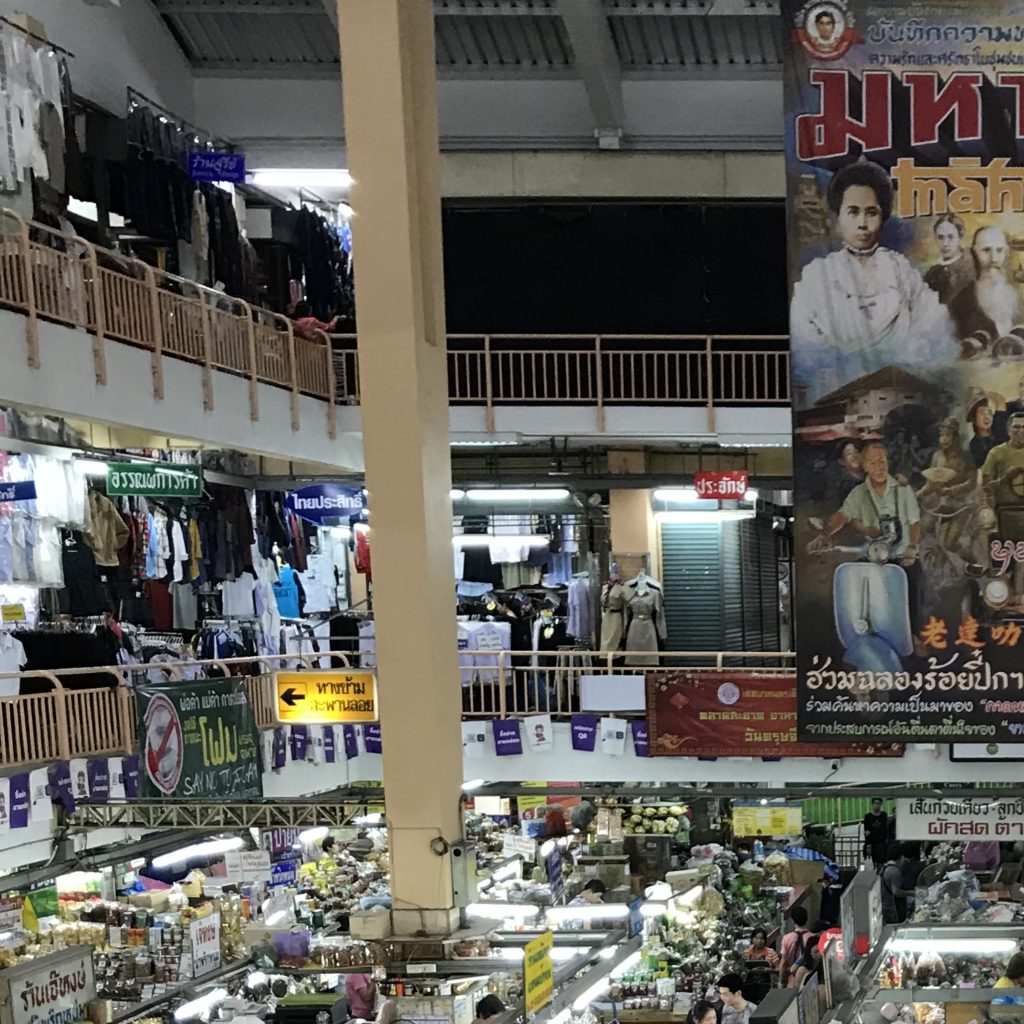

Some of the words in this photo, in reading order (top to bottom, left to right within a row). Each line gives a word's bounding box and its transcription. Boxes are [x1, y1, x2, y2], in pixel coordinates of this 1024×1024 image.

[316, 676, 366, 695] ทางข้าม
[312, 697, 374, 712] สะพานลอย
[199, 716, 238, 767] โฟม
[928, 817, 989, 836] ผักสด
